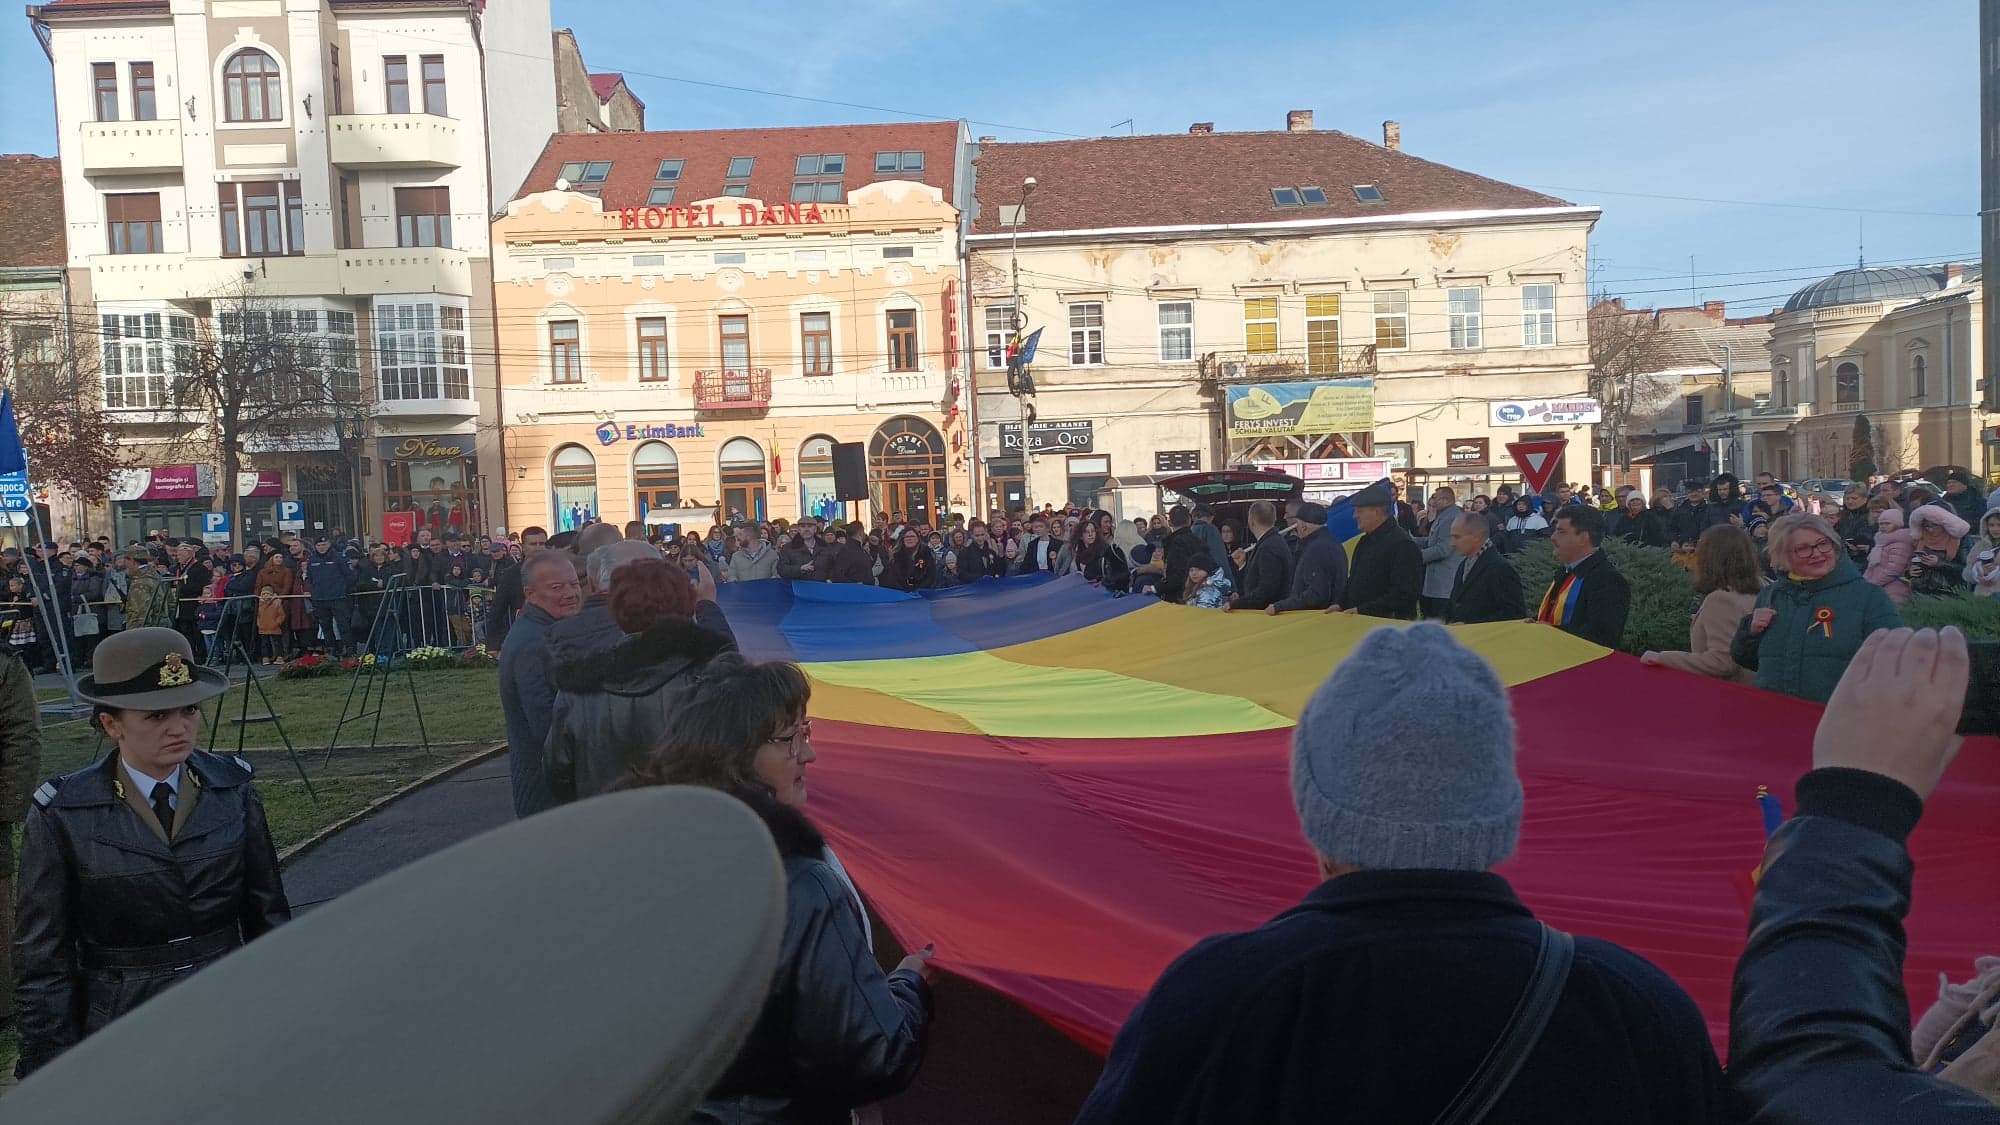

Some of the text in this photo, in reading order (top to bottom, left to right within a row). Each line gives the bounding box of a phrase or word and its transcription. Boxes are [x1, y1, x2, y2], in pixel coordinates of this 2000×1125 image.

[620, 201, 825, 230] HOTEL DANA
[626, 422, 704, 441] EximBank
[1234, 420, 1261, 429] FERYS
[1263, 418, 1295, 427] INVEST
[395, 438, 461, 457] Nina
[889, 435, 922, 449] HOTEL
[1004, 432, 1088, 448] Roza Oro
[282, 502, 298, 520] P
[207, 513, 224, 531] P
